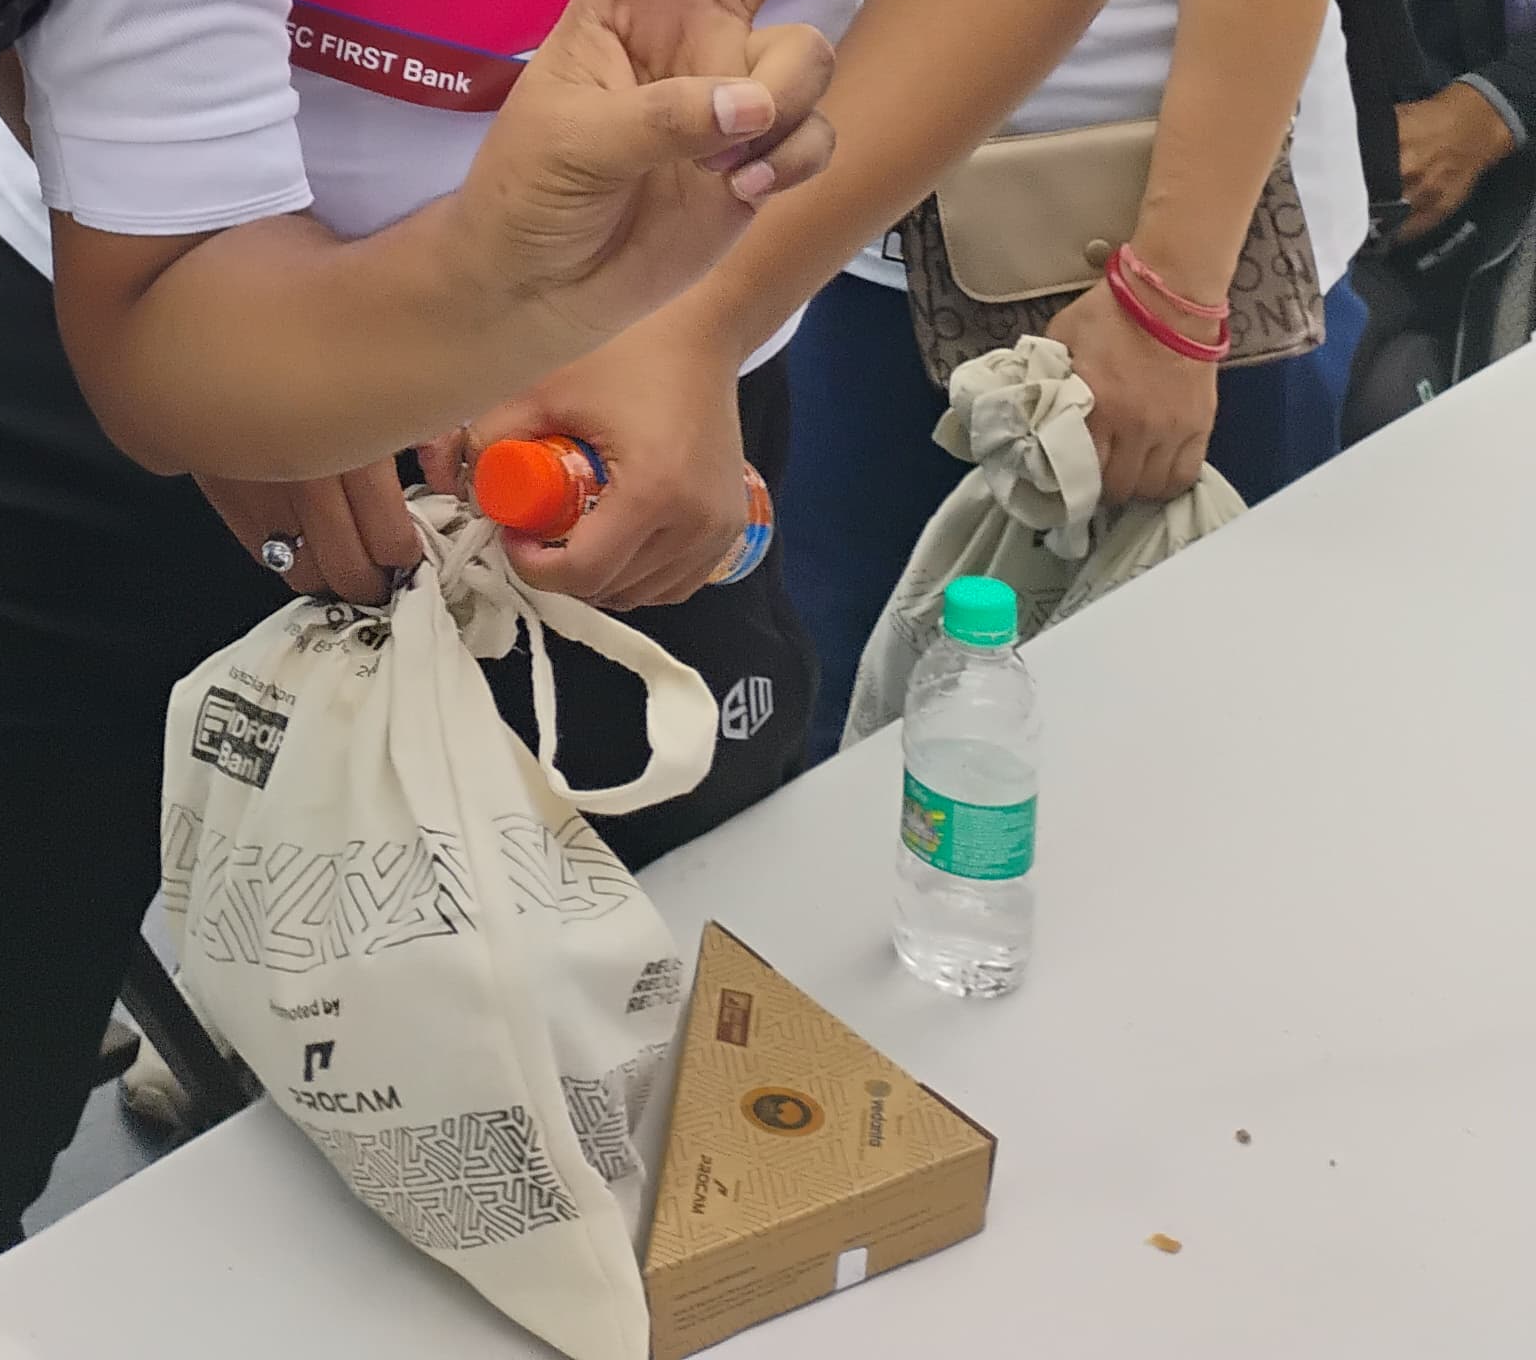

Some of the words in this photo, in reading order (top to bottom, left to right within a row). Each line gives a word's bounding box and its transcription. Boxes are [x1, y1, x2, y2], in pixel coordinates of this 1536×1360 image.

[320, 33, 399, 75] FIRST
[402, 57, 473, 95] Bank
[321, 997, 341, 1018] by
[691, 1153, 713, 1216] PROCAM
